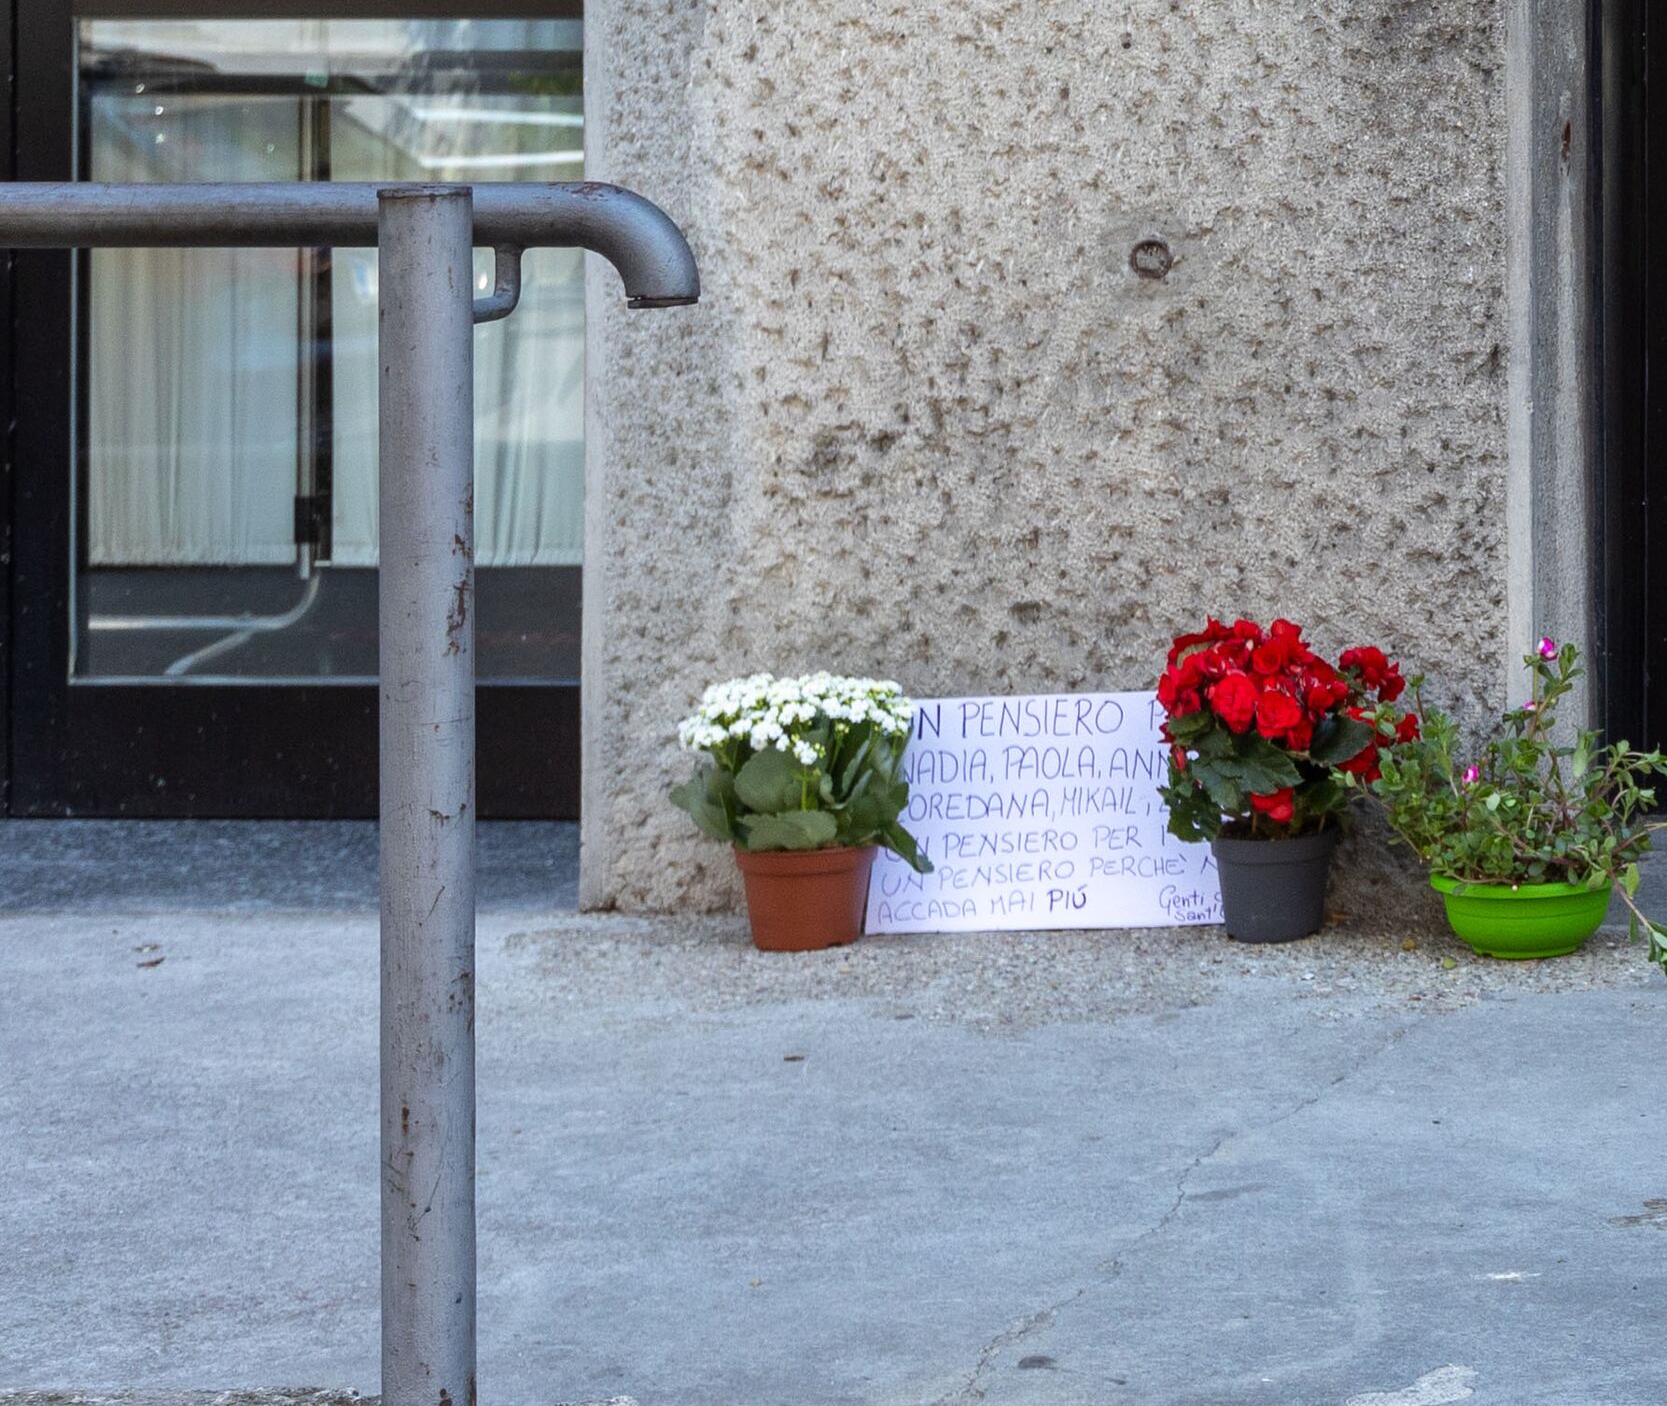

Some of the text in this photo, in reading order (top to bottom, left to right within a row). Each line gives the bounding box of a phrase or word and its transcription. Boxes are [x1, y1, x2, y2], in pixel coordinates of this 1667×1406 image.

[911, 703, 941, 740] N
[958, 700, 1124, 739] PENSIERO
[1003, 745, 1101, 781] PAOLA,
[899, 787, 1055, 823] OREDANA,
[942, 829, 1078, 859] PENSIERO
[1092, 825, 1142, 850] PER
[881, 871, 924, 897] UN
[938, 859, 1075, 891] PENSIERO
[878, 898, 977, 925] ACCADA
[991, 889, 1034, 915] MAI
